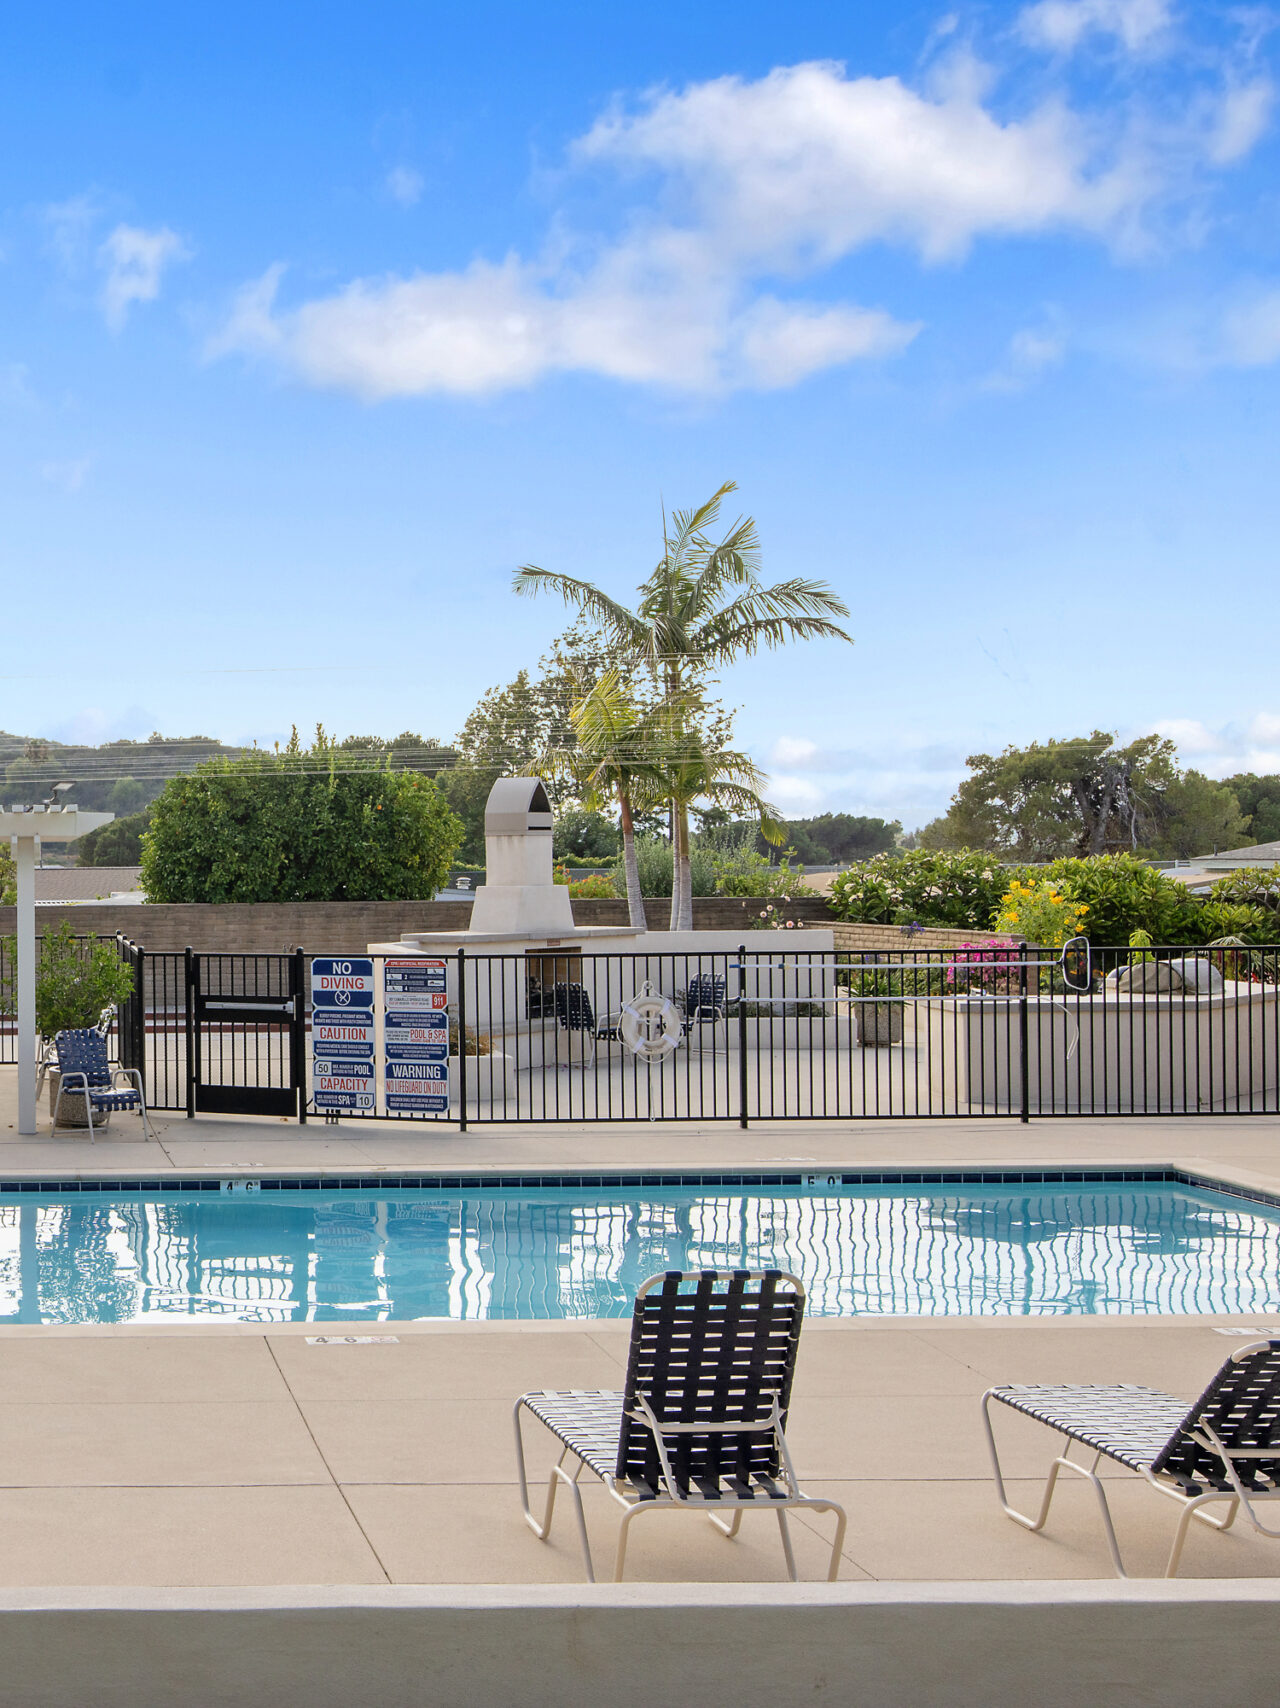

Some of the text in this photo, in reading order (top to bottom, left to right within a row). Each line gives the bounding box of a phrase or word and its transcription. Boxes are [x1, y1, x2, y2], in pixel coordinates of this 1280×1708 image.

[332, 962, 352, 975] NO
[321, 977, 365, 990] DIVING
[434, 996, 444, 1006] 911
[320, 1027, 366, 1041] CAUTION
[410, 1029, 427, 1039] POOL
[428, 1030, 433, 1039] &
[434, 1030, 446, 1040] SPA
[318, 1064, 329, 1073] 50
[354, 1065, 371, 1075] POOL
[392, 1065, 441, 1079] WARNING
[320, 1077, 368, 1091] CAPACITY
[386, 1080, 446, 1095] NO LIFEGUARD ON DUTY
[338, 1095, 350, 1105] SPA
[360, 1096, 370, 1106] 10
